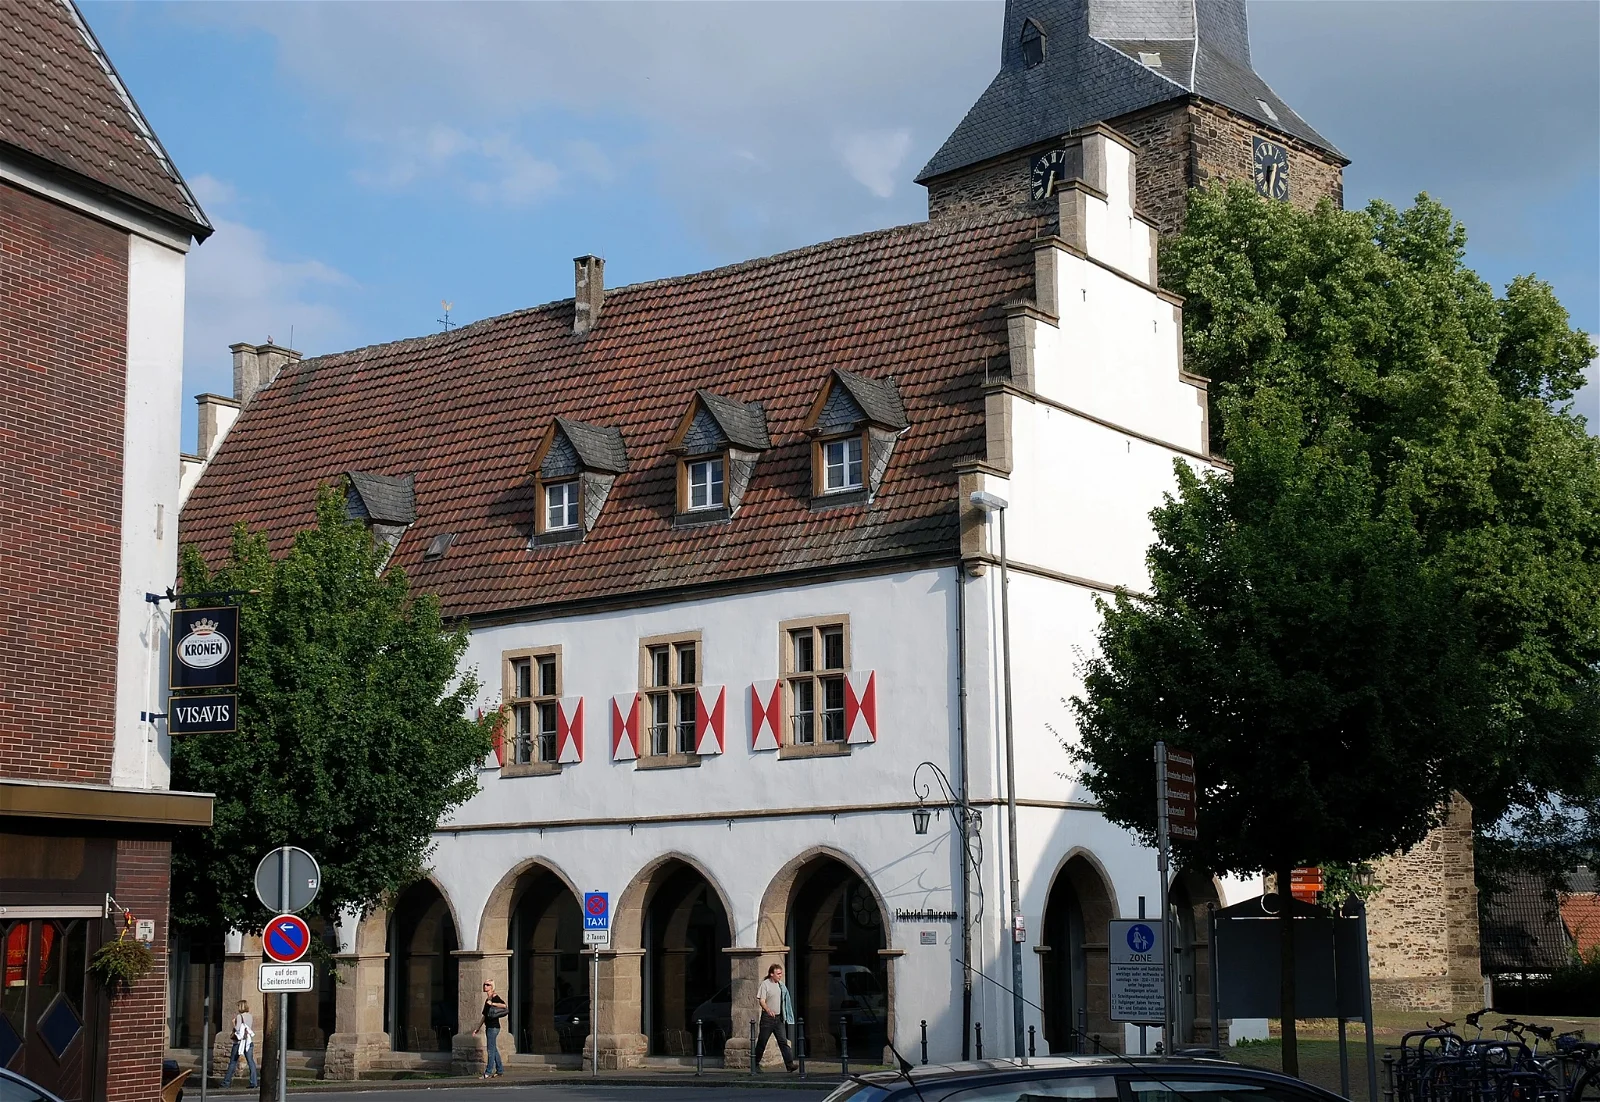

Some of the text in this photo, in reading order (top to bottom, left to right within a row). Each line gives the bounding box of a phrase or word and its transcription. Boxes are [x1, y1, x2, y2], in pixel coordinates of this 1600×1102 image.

[185, 643, 222, 656] KRONEN
[176, 704, 230, 723] VISAVIS
[586, 918, 606, 926] TAXI
